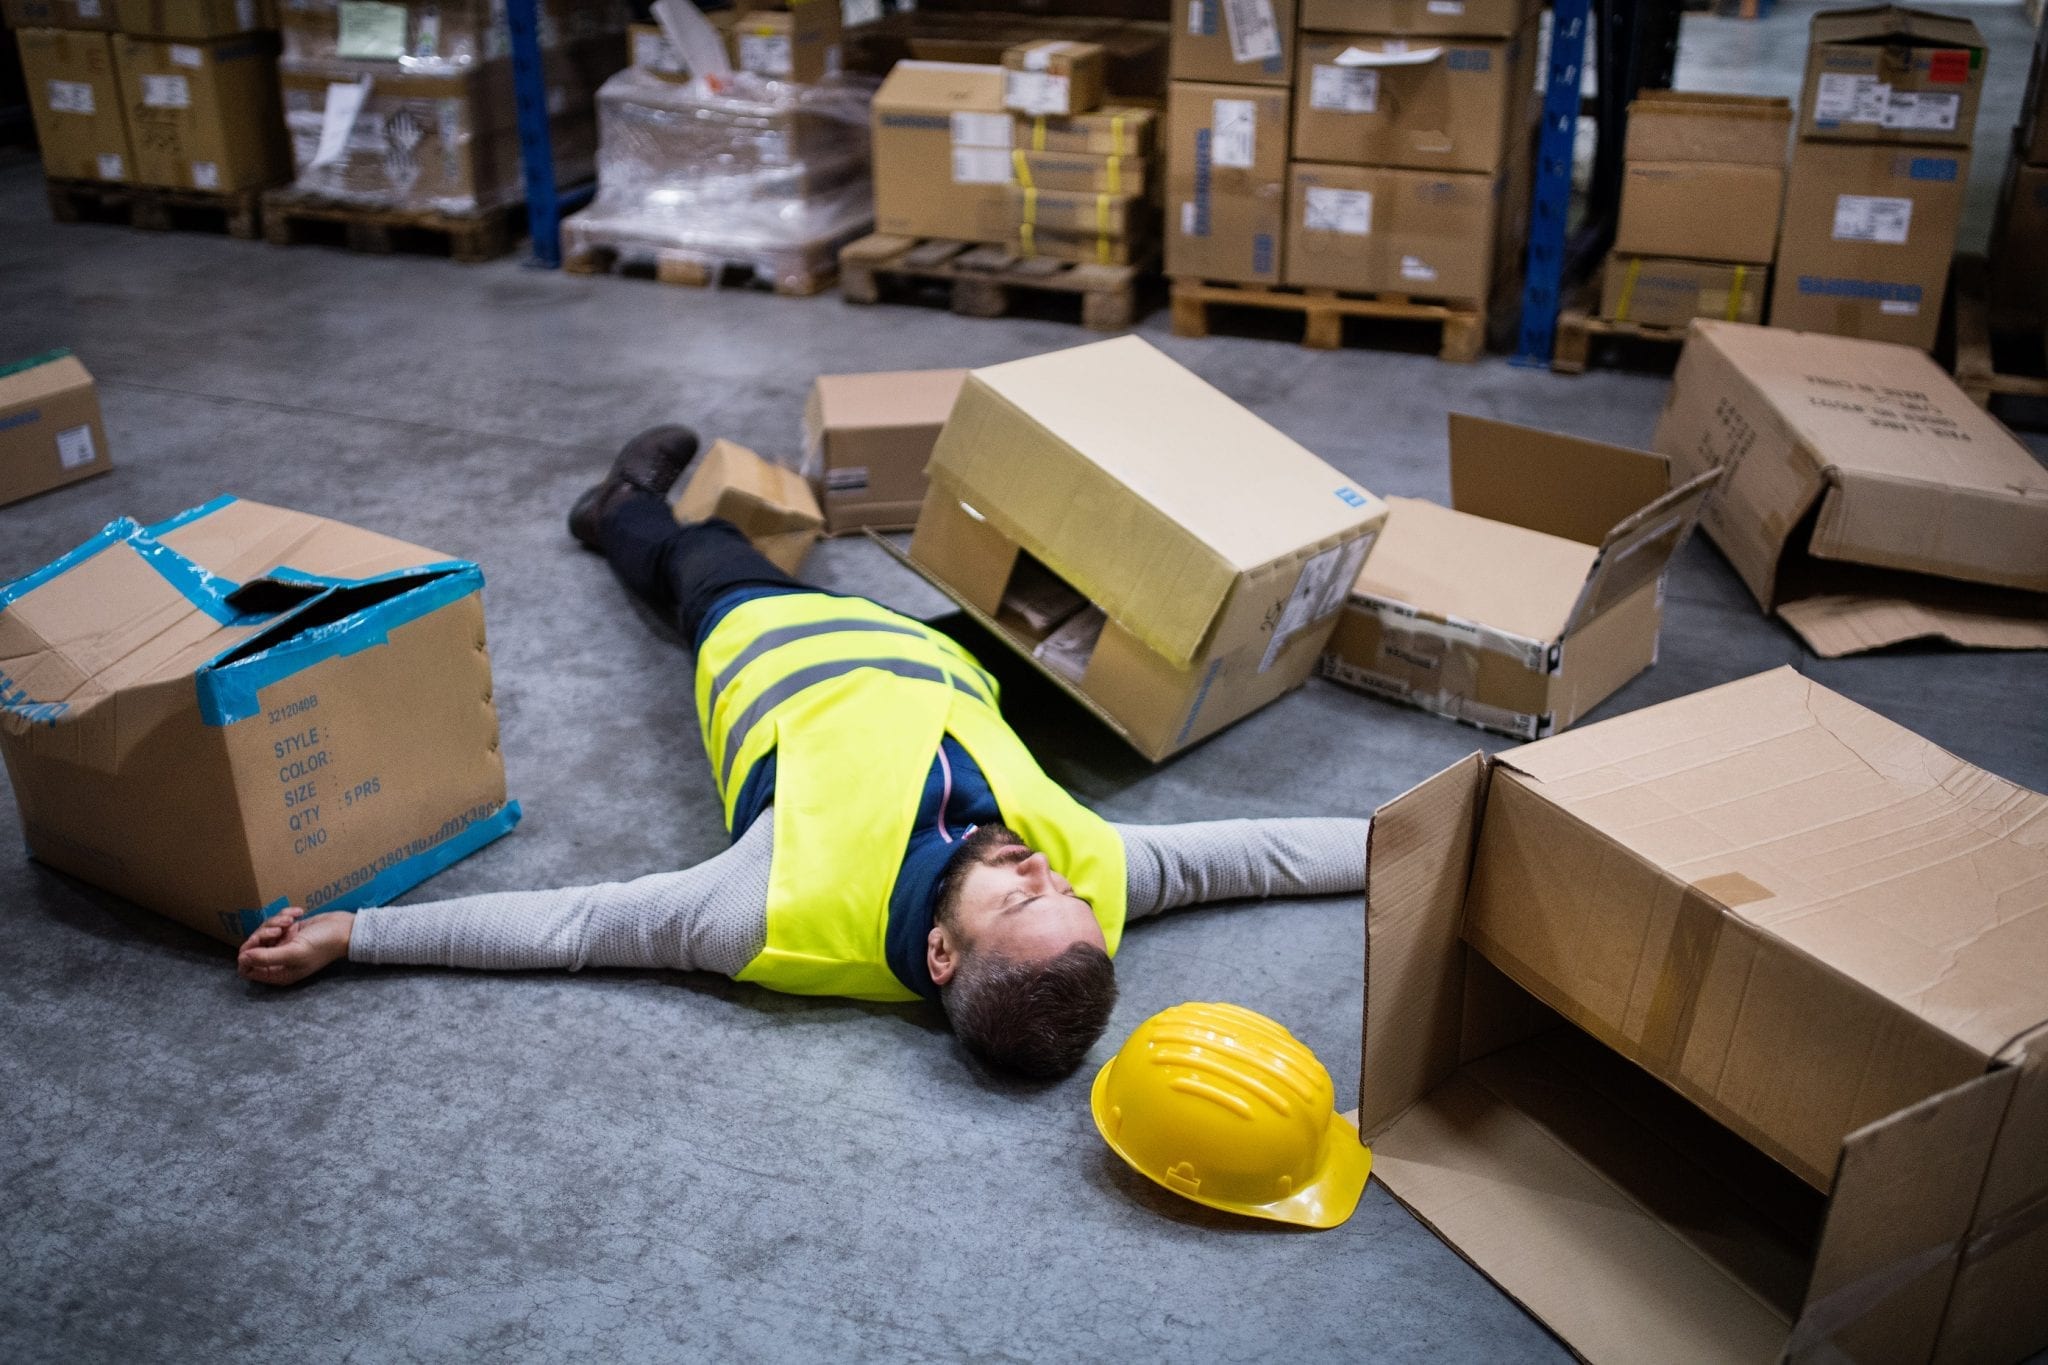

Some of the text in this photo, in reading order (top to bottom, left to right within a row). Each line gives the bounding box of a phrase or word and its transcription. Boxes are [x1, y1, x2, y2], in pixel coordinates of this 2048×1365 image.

[274, 727, 320, 758] STYLE
[284, 781, 318, 808] SIZE
[289, 805, 320, 831] Q'TY
[294, 827, 328, 855] C/NO
